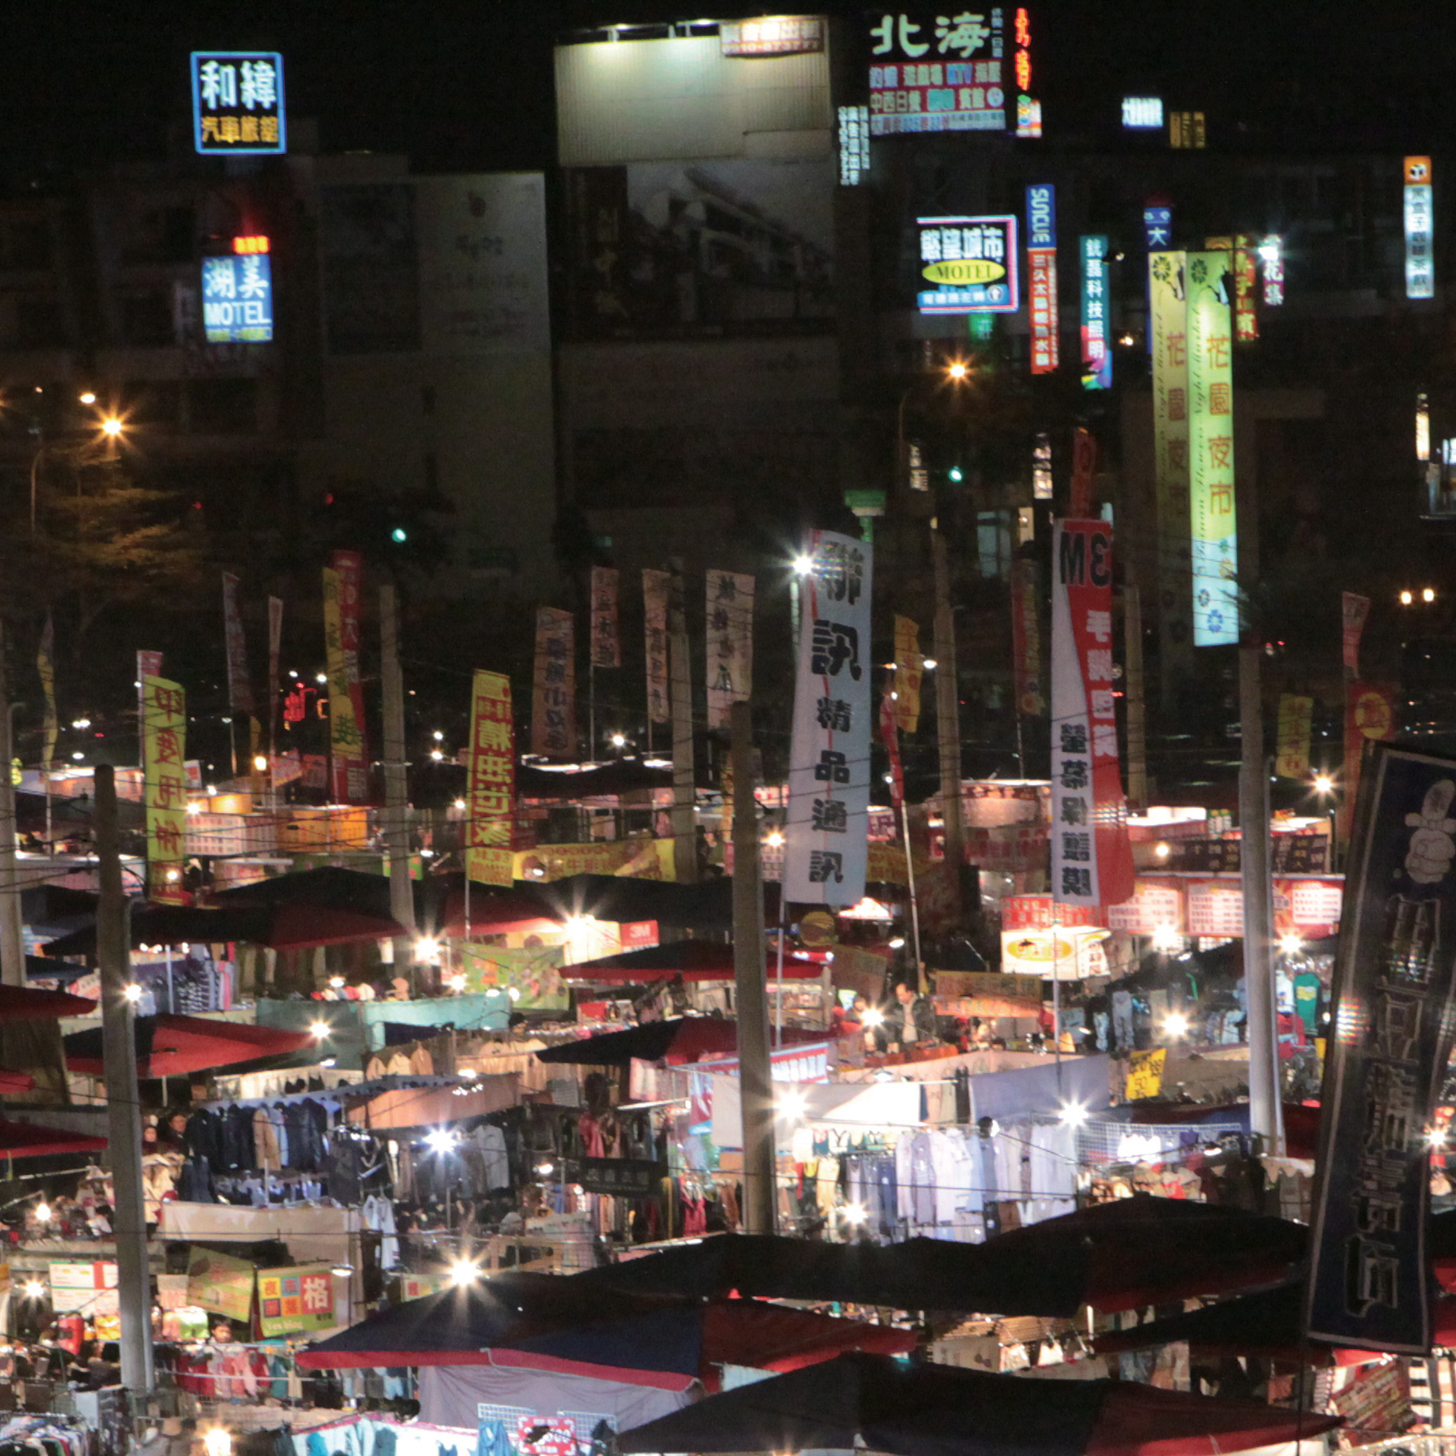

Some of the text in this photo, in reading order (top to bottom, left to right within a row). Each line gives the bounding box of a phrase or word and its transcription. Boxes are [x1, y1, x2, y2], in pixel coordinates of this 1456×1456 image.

[870, 12, 990, 58] 北海
[200, 60, 278, 110] 和緯
[1031, 188, 1051, 244] SUNCUE
[204, 257, 269, 299] 湖美
[936, 262, 997, 279] MOTEL
[204, 301, 272, 325] MOTEL
[1206, 334, 1234, 515] 花園夜市
